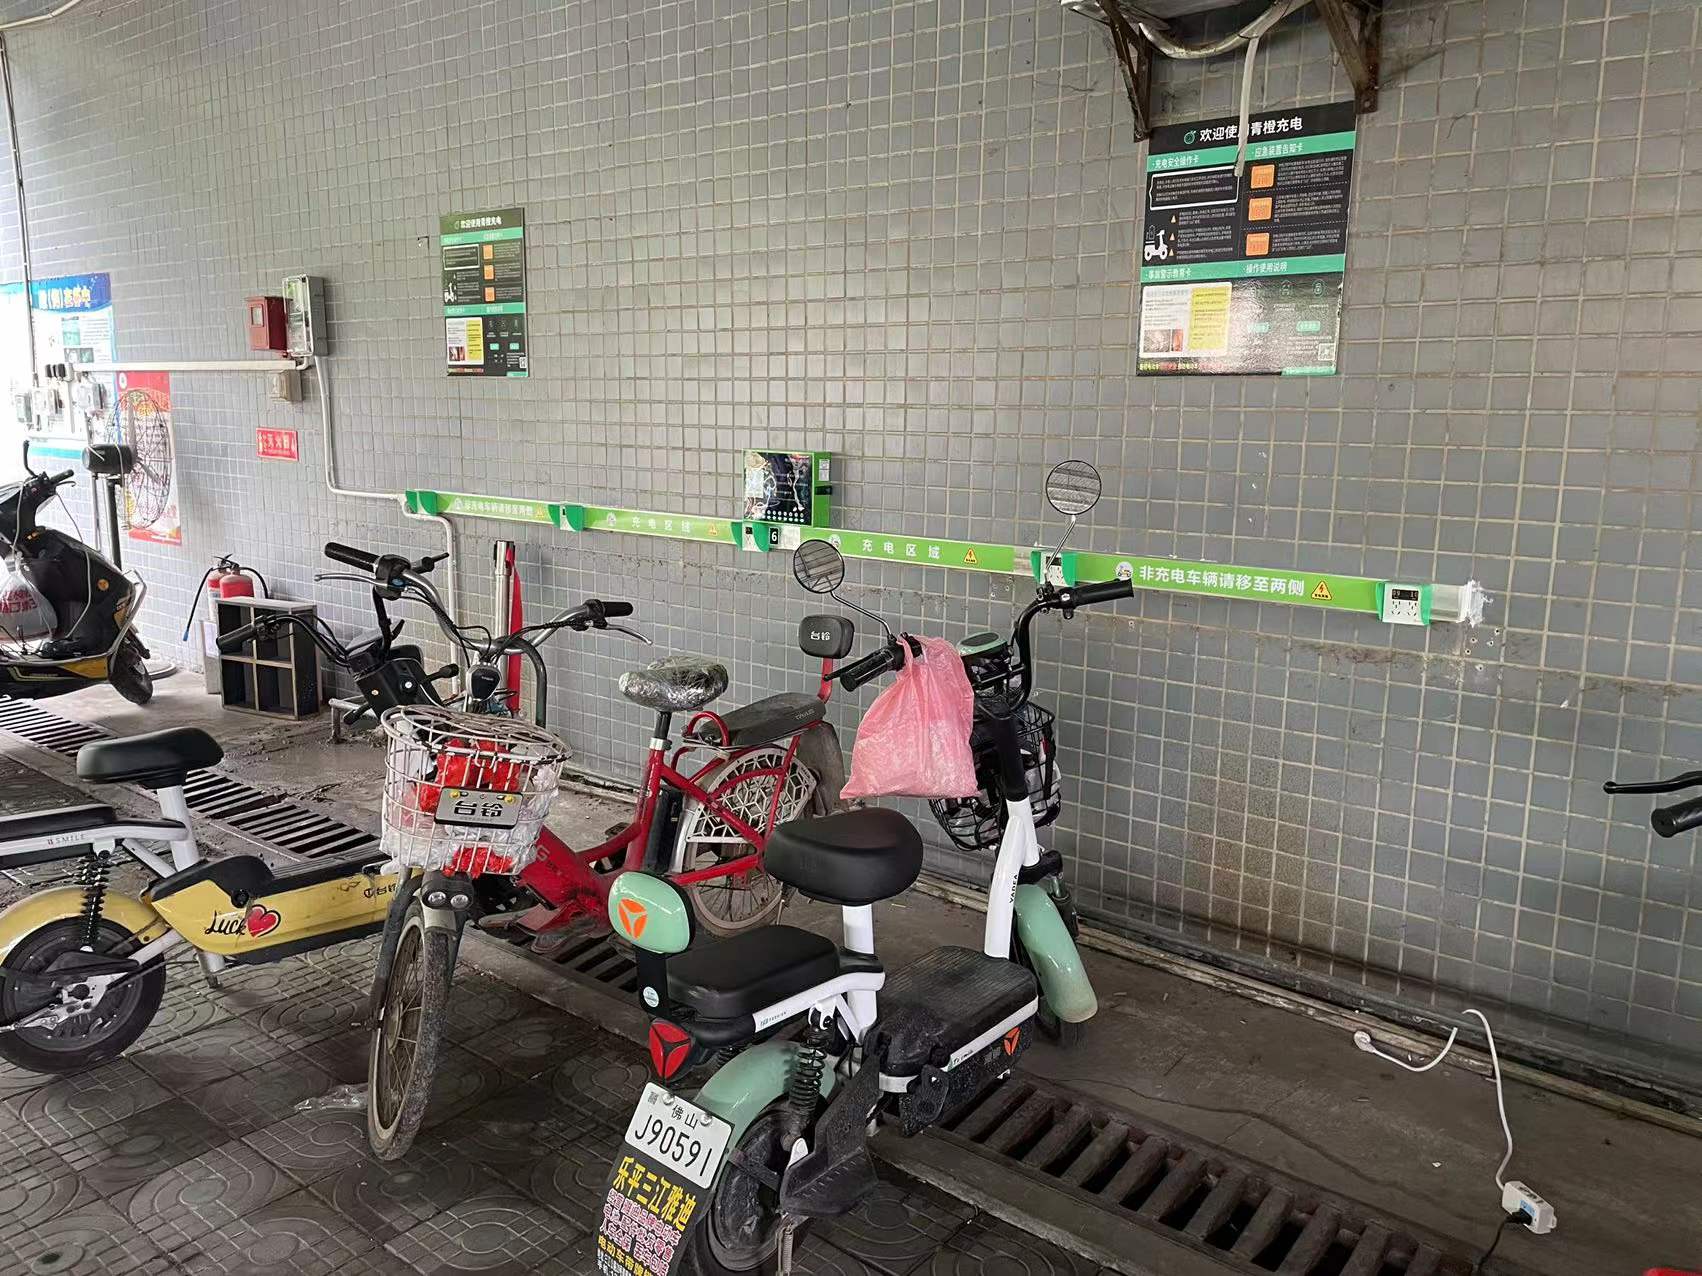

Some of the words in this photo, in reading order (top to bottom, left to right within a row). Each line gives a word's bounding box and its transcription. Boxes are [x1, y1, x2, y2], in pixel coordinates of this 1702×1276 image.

[1199, 116, 1303, 142] 欢迎使青橙充电
[632, 516, 691, 534] 充电区域
[771, 531, 777, 542] 6
[862, 539, 941, 560] 充电区域
[1139, 564, 1305, 596] 非充电车辆请移至两侧
[454, 800, 504, 818] 台铃
[671, 1104, 699, 1130] 佛山
[634, 1114, 713, 1176] J90591
[612, 1155, 697, 1232] 乐平三江雅迪
